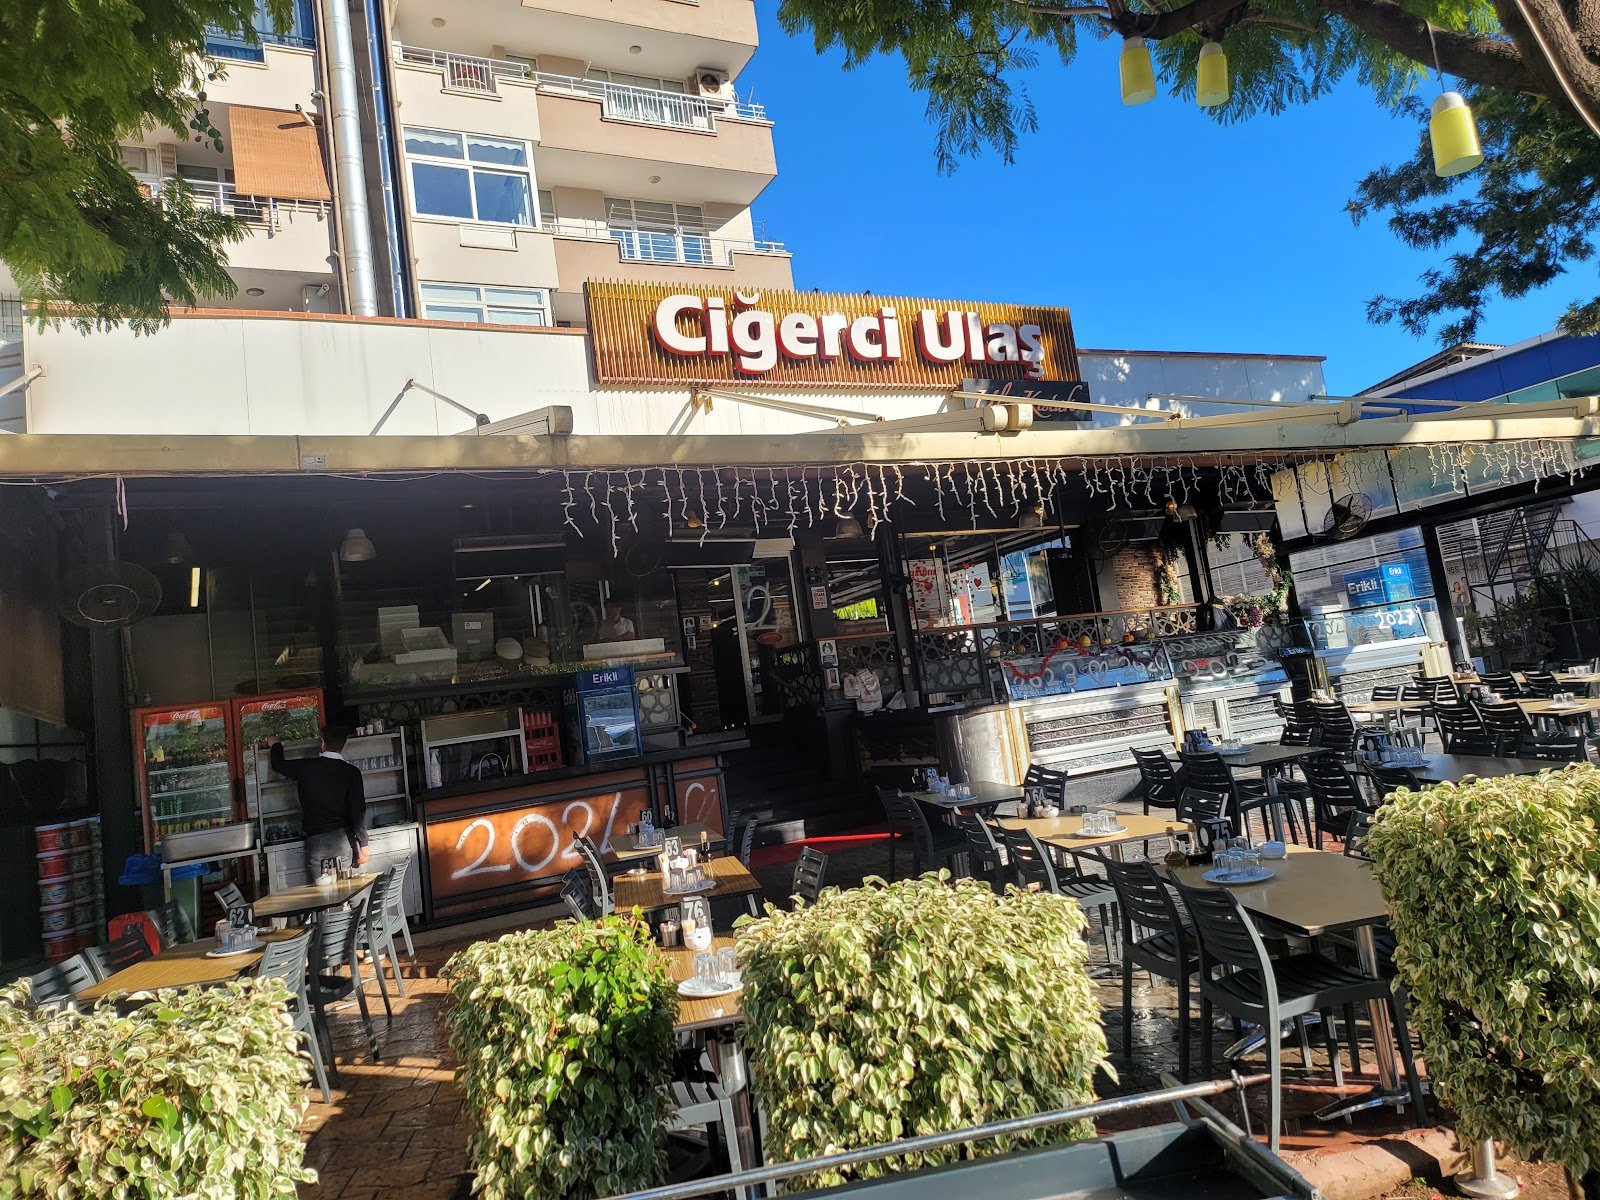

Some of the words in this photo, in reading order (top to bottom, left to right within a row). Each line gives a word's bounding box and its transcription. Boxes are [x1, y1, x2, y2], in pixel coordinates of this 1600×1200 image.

[656, 291, 900, 372] Ciğerci
[920, 309, 1045, 377] Ulaş
[1347, 578, 1378, 594] Erikli
[592, 672, 618, 684] Erikli
[641, 810, 653, 823] 60
[1212, 822, 1231, 841] 75
[665, 839, 679, 857] 63
[229, 907, 245, 928] 62
[684, 901, 704, 920] 76
